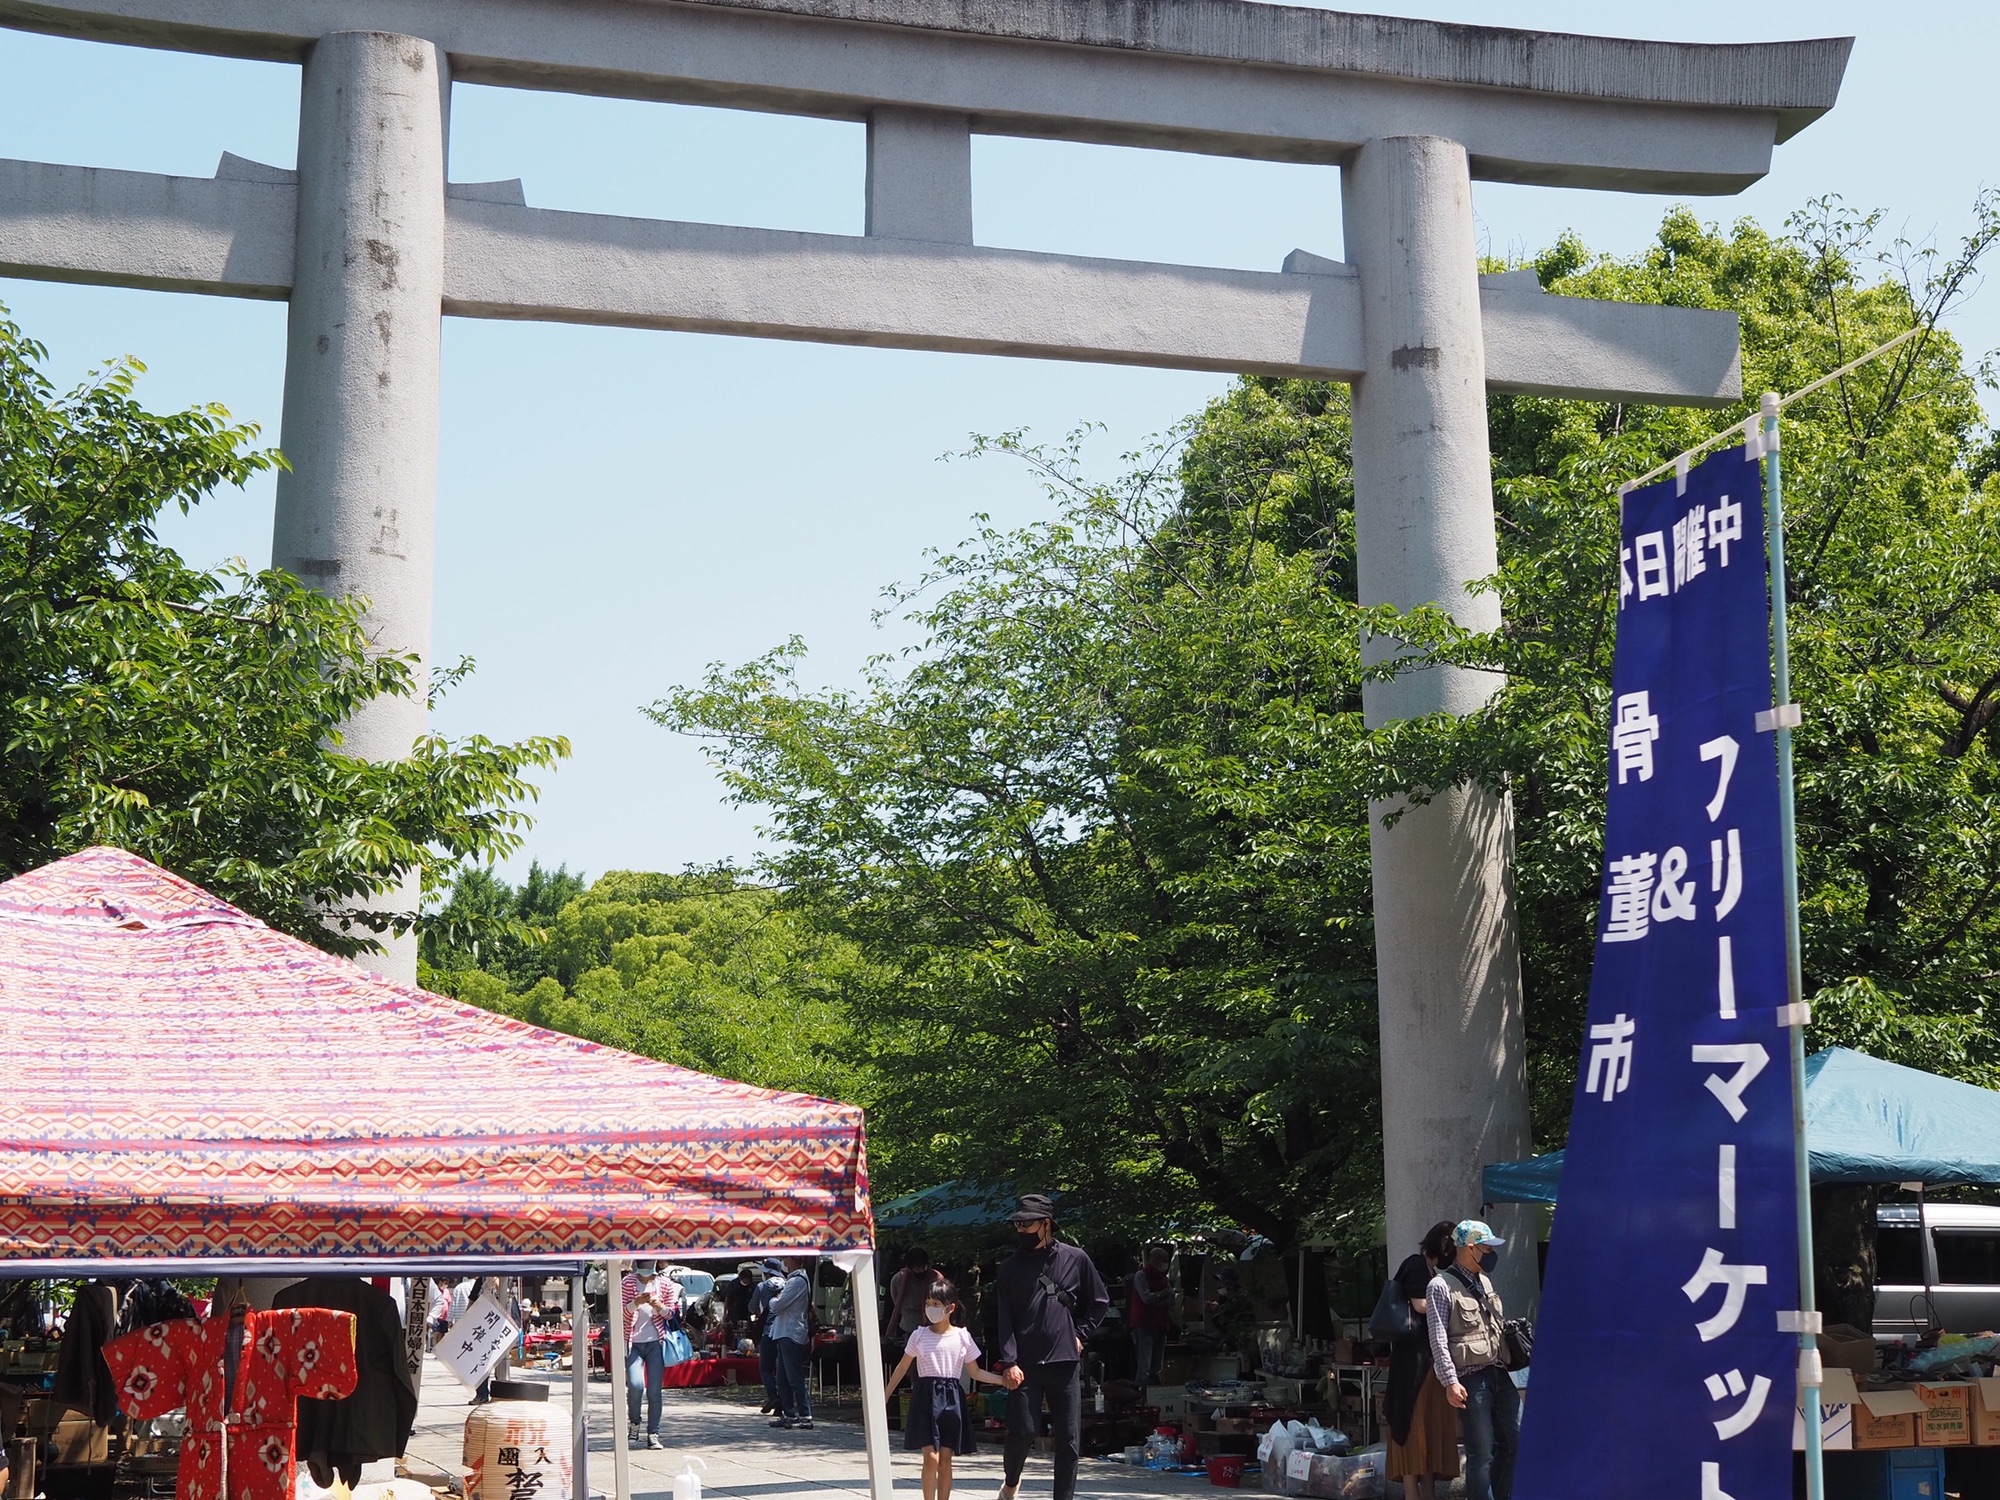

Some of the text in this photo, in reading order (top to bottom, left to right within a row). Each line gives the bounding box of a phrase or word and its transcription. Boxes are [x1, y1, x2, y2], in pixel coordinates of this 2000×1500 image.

[1586, 691, 1659, 1102] 骨董市
[1652, 846, 1697, 922] &
